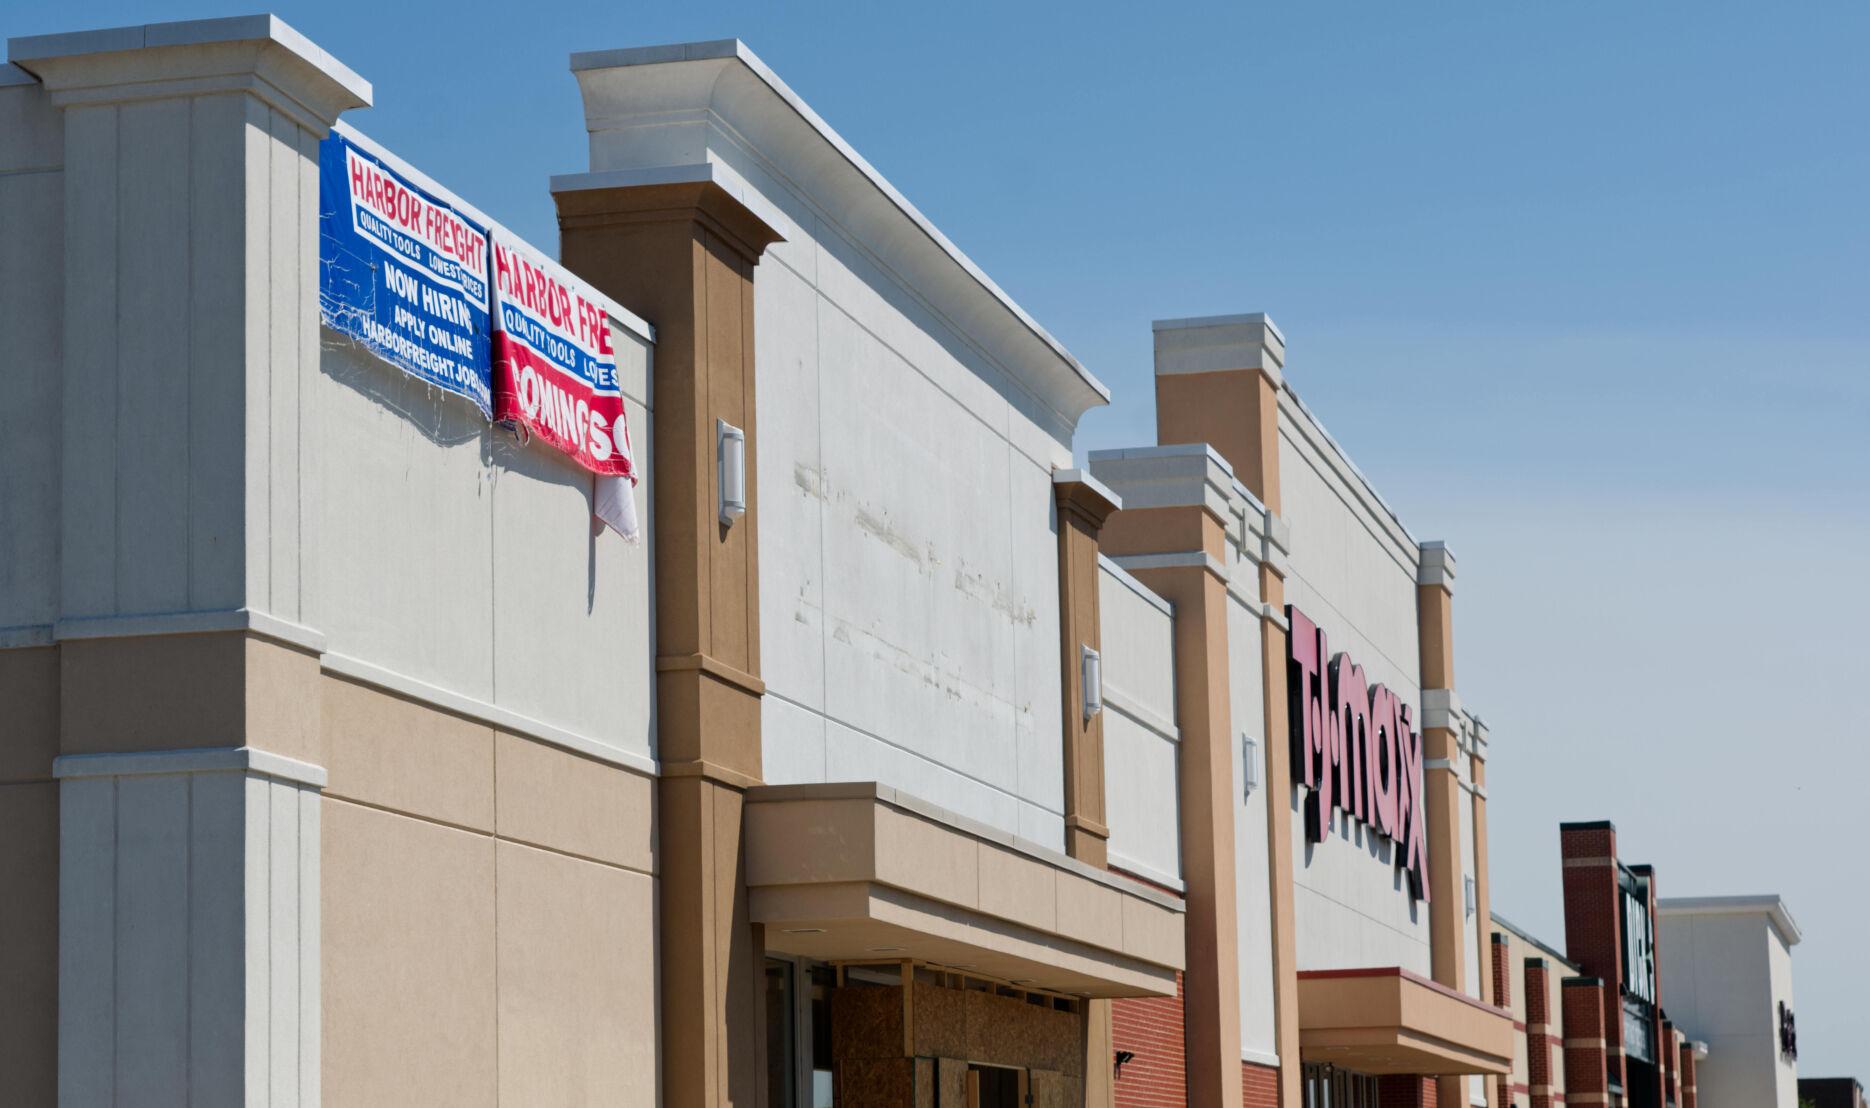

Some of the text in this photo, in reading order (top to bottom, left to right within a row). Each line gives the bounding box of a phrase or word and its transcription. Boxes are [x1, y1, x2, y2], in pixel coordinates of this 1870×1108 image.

[351, 156, 483, 274] HARBOR FREIGHT
[360, 211, 483, 299] QUALITY TOOLS LOWEST RICES
[384, 260, 473, 336] NOW HIRIN
[495, 243, 576, 337] HARBOR
[395, 304, 474, 360] APPLY ONLINE
[505, 308, 545, 351] QUALITY
[545, 334, 576, 368] TOOLS
